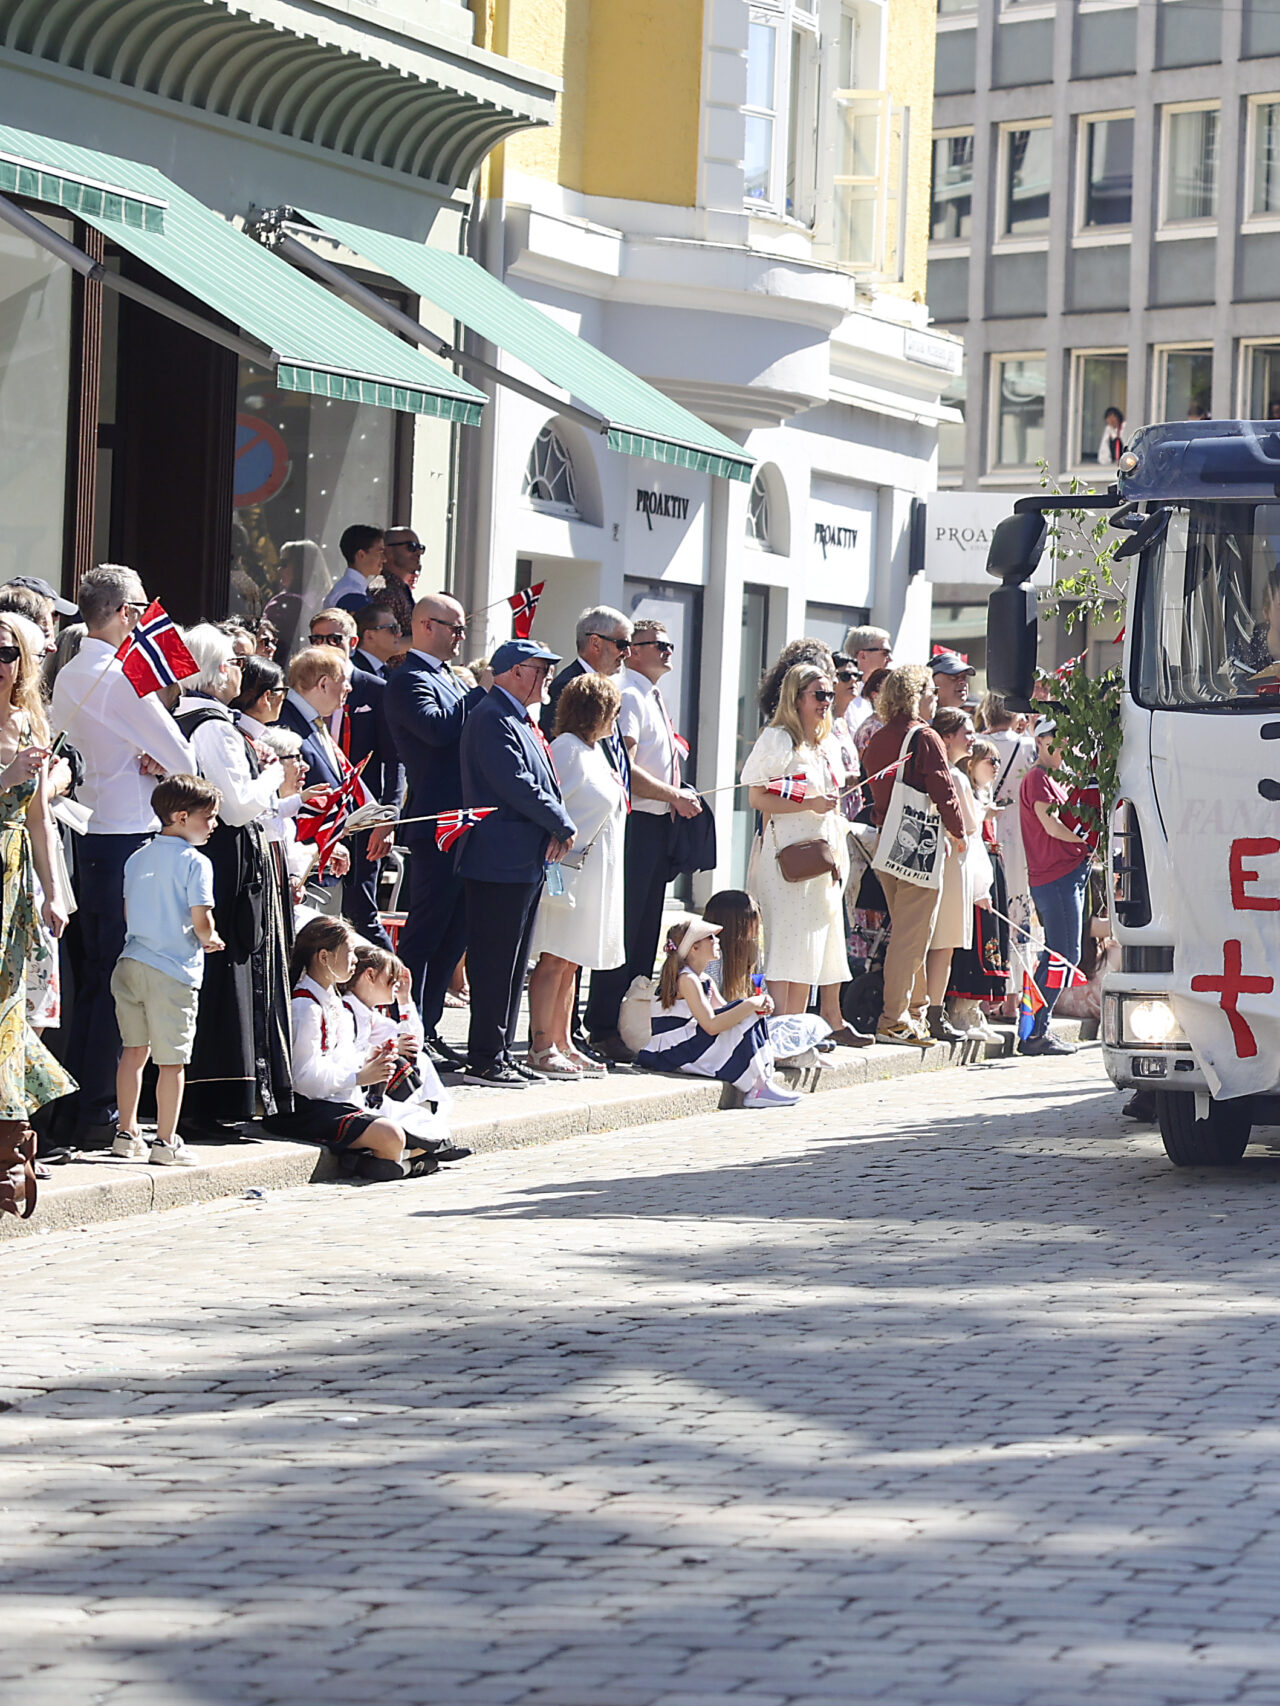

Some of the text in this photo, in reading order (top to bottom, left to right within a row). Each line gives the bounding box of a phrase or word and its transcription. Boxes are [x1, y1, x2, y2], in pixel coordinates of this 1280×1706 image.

[636, 488, 689, 531] PROAKTIV
[814, 522, 858, 560] PROAKTIV
[936, 527, 996, 551] PROA
